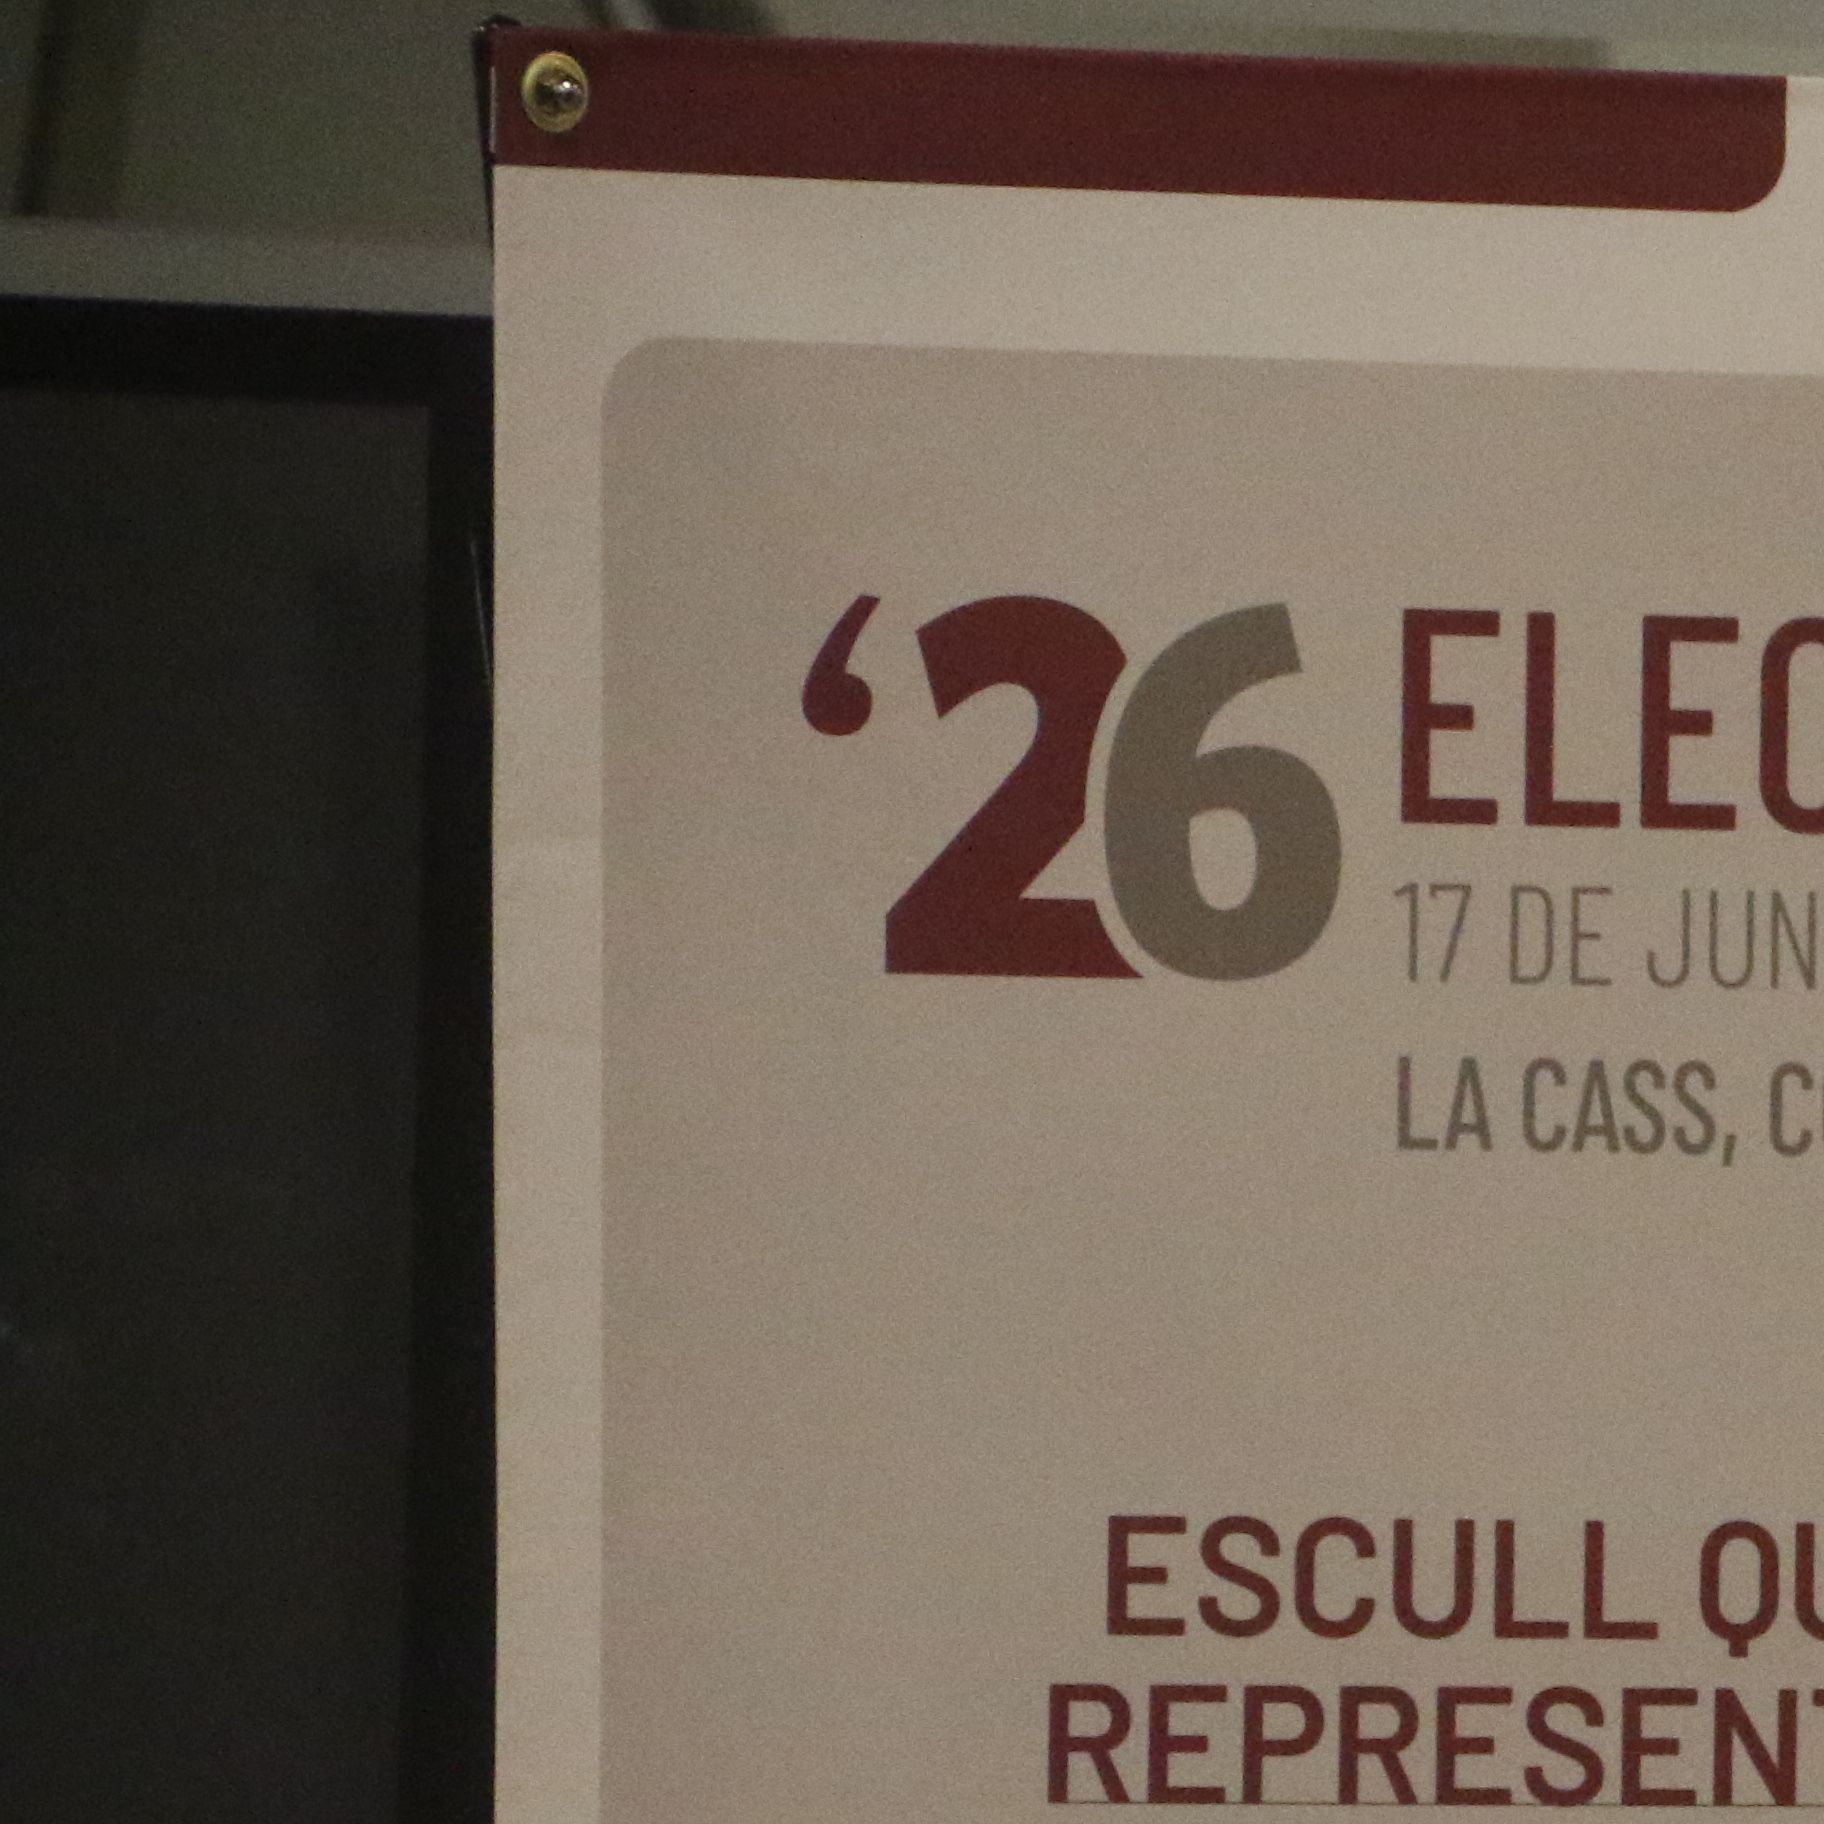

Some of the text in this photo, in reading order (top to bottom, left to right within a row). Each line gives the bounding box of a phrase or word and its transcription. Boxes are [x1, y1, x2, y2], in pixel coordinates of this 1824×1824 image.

[1394, 882, 1473, 982] 17
[1508, 884, 1612, 987] DE
[1397, 1056, 1492, 1151] LA
[1522, 1057, 1736, 1166] CASS,
[1107, 1515, 1658, 1640] ESCULL
